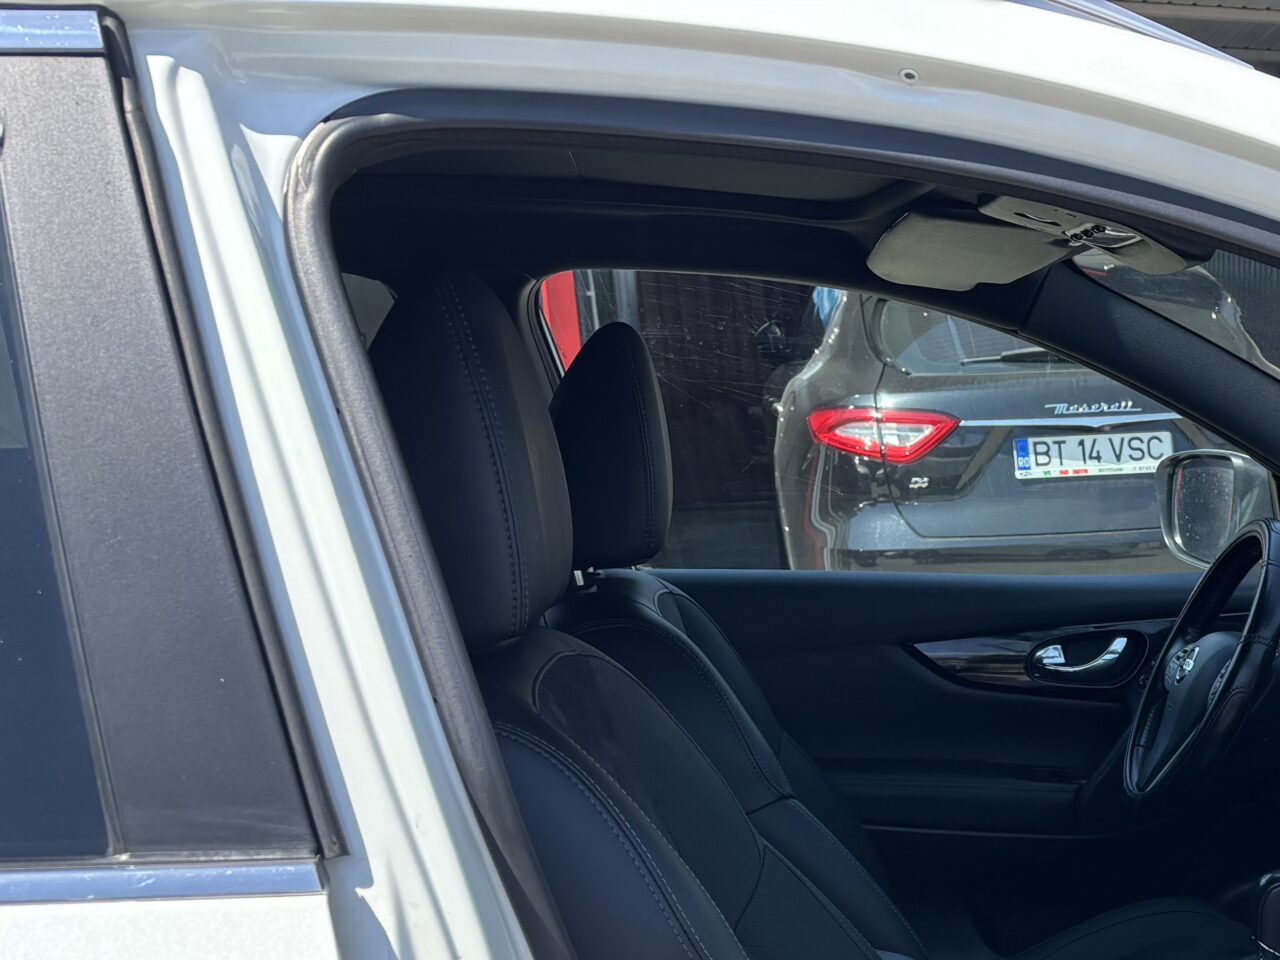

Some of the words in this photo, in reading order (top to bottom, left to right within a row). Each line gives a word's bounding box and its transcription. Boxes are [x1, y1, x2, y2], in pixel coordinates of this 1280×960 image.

[1033, 440, 1067, 466] BT
[1078, 438, 1102, 464] 14
[1108, 436, 1164, 462] VSC
[1018, 456, 1030, 468] RO
